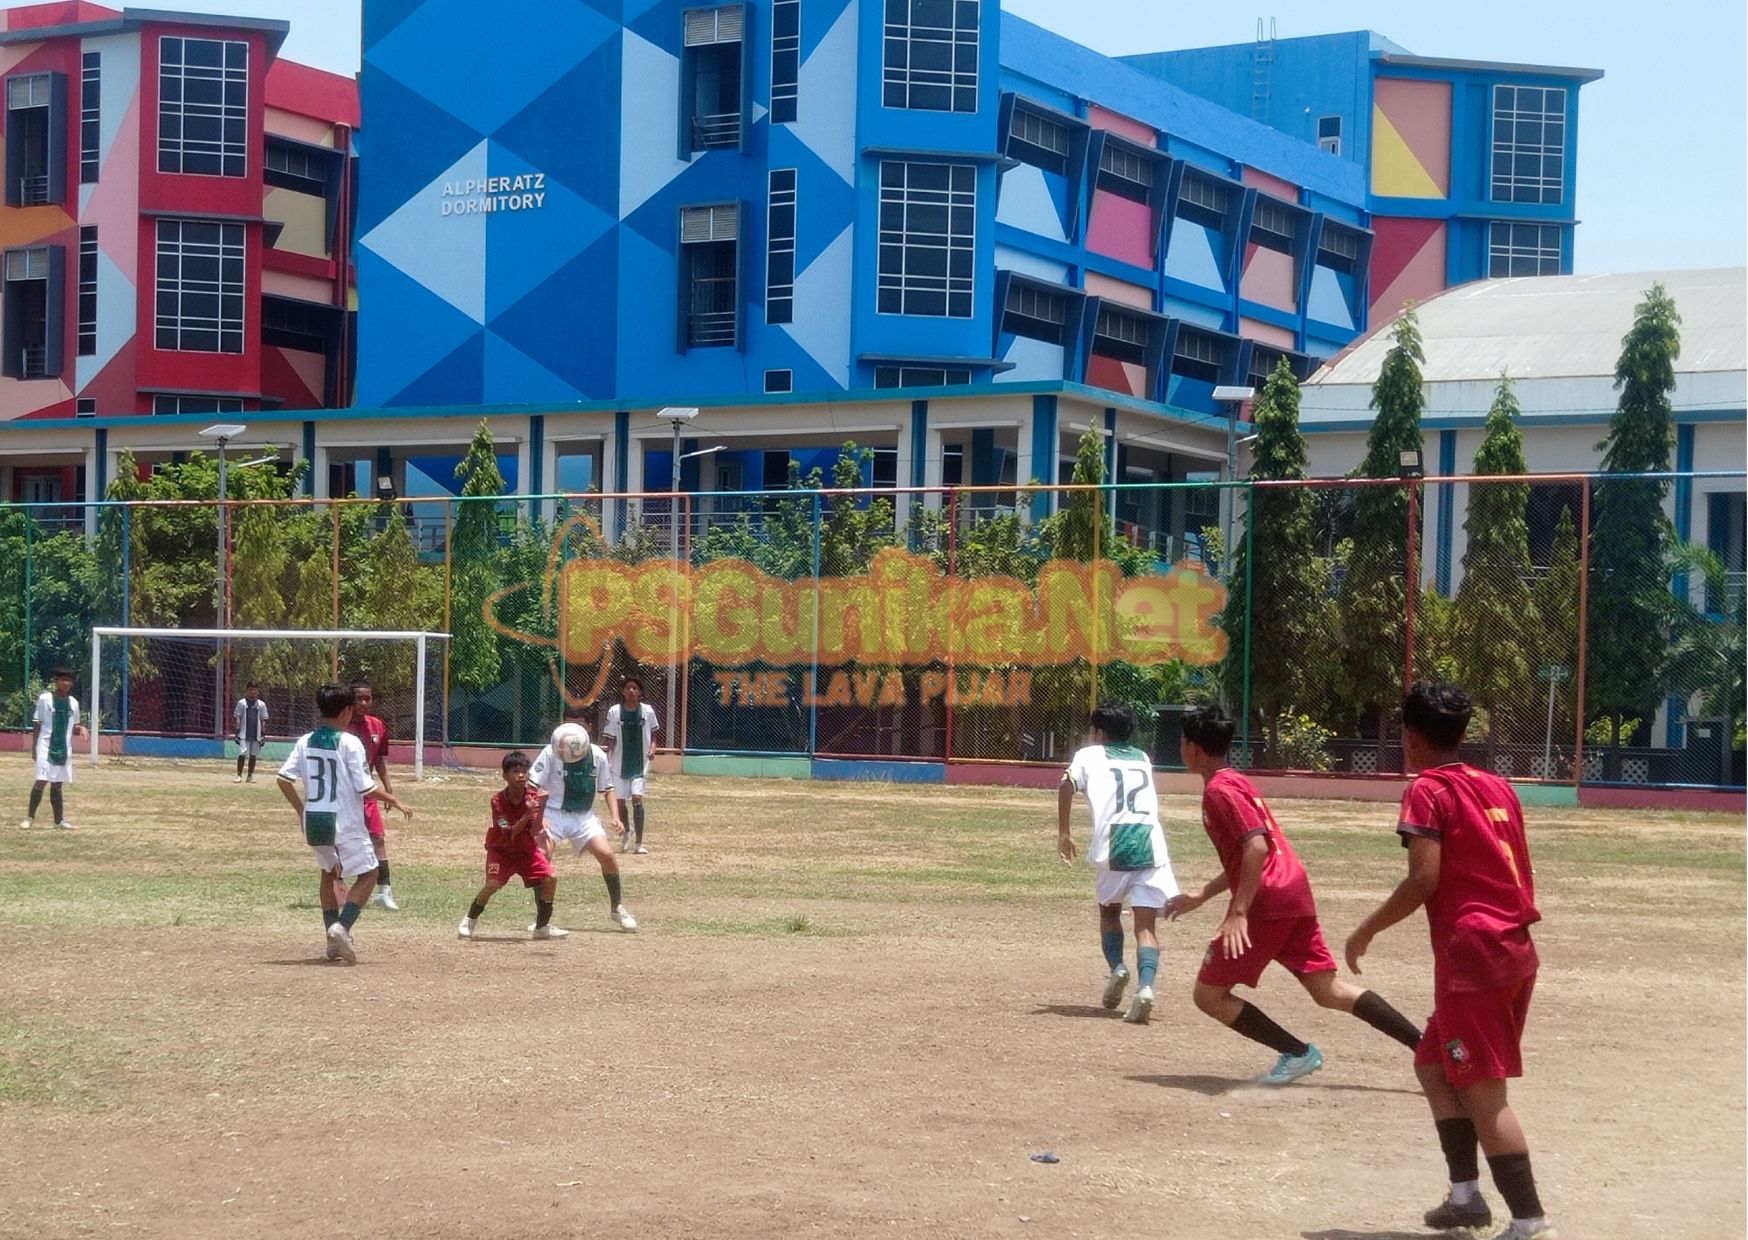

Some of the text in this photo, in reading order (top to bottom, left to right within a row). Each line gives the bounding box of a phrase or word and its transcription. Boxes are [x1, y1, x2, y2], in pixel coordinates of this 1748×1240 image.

[443, 173, 545, 197] ALPHERATZ
[441, 193, 545, 216] DORMITORY
[306, 755, 337, 803] 31
[1110, 767, 1150, 815] 12
